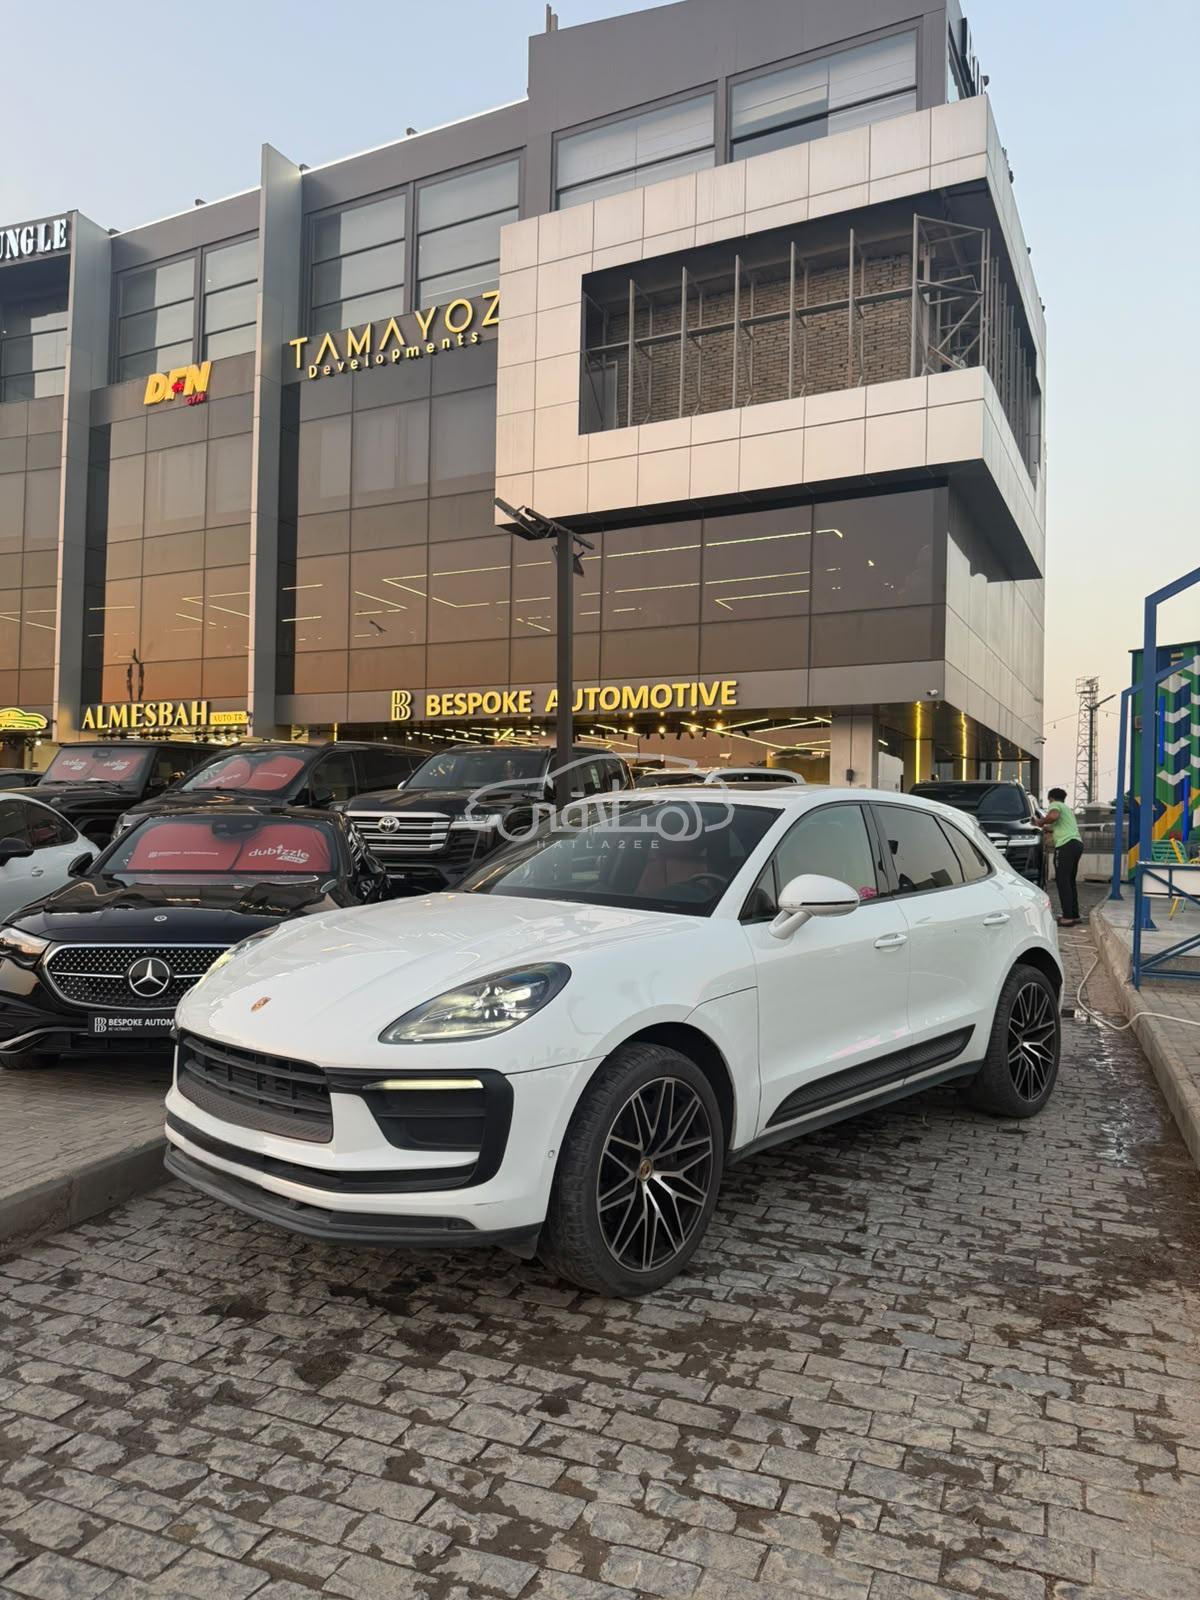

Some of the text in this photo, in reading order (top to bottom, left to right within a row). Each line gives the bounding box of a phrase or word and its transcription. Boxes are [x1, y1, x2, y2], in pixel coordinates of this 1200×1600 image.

[289, 290, 500, 369] TAMAYOZ
[308, 331, 480, 379] Developments
[81, 700, 207, 729] ALMESBAH
[426, 690, 532, 717] BESPOKE
[545, 680, 737, 713] AUTOMOTIVE
[248, 844, 310, 859] dubizzle
[108, 1018, 142, 1026] BESPOKE
